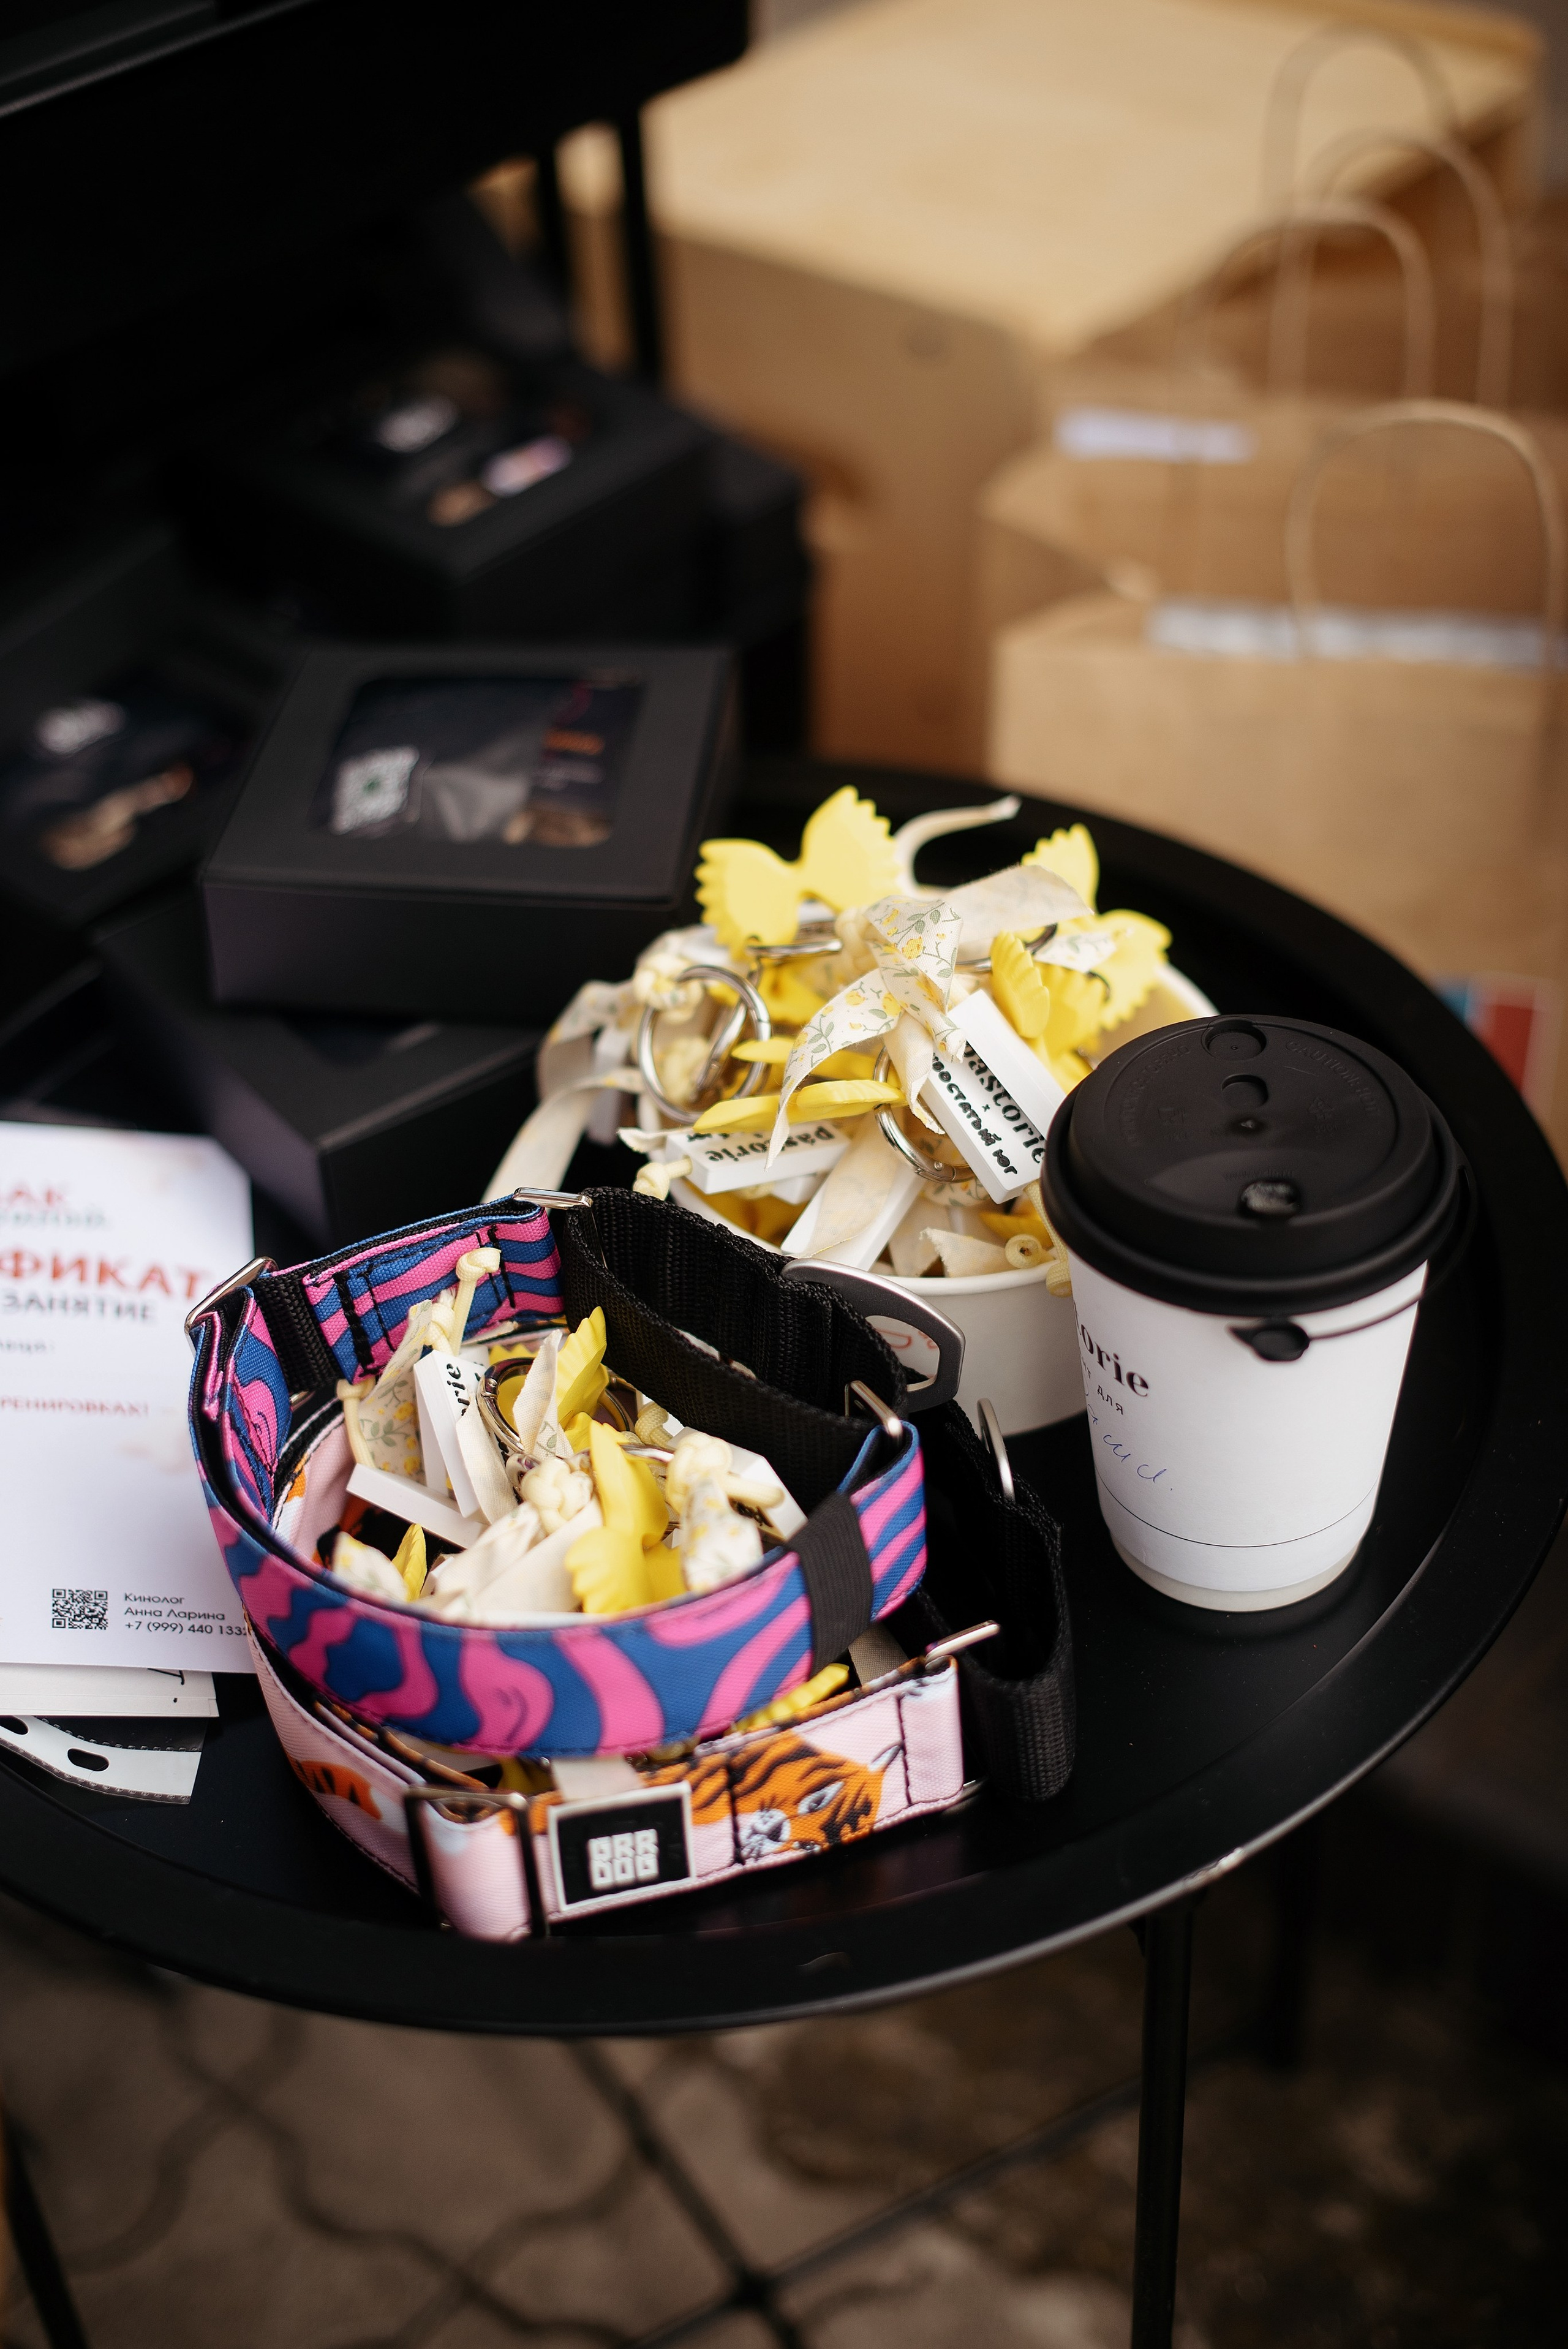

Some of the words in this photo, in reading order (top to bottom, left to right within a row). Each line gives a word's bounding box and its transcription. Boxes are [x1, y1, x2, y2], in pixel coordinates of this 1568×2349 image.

[704, 1125, 835, 1162] pasorie
[2, 1292, 157, 1322] ЗАНЯТИЕ
[1096, 1384, 1124, 1415] для
[124, 1593, 185, 1605] Кинолог
[124, 1607, 162, 1617] Анна
[167, 1608, 225, 1621] Ларина
[125, 1621, 142, 1630] +7
[147, 1621, 184, 1634] (999)
[187, 1624, 213, 1634] 440
